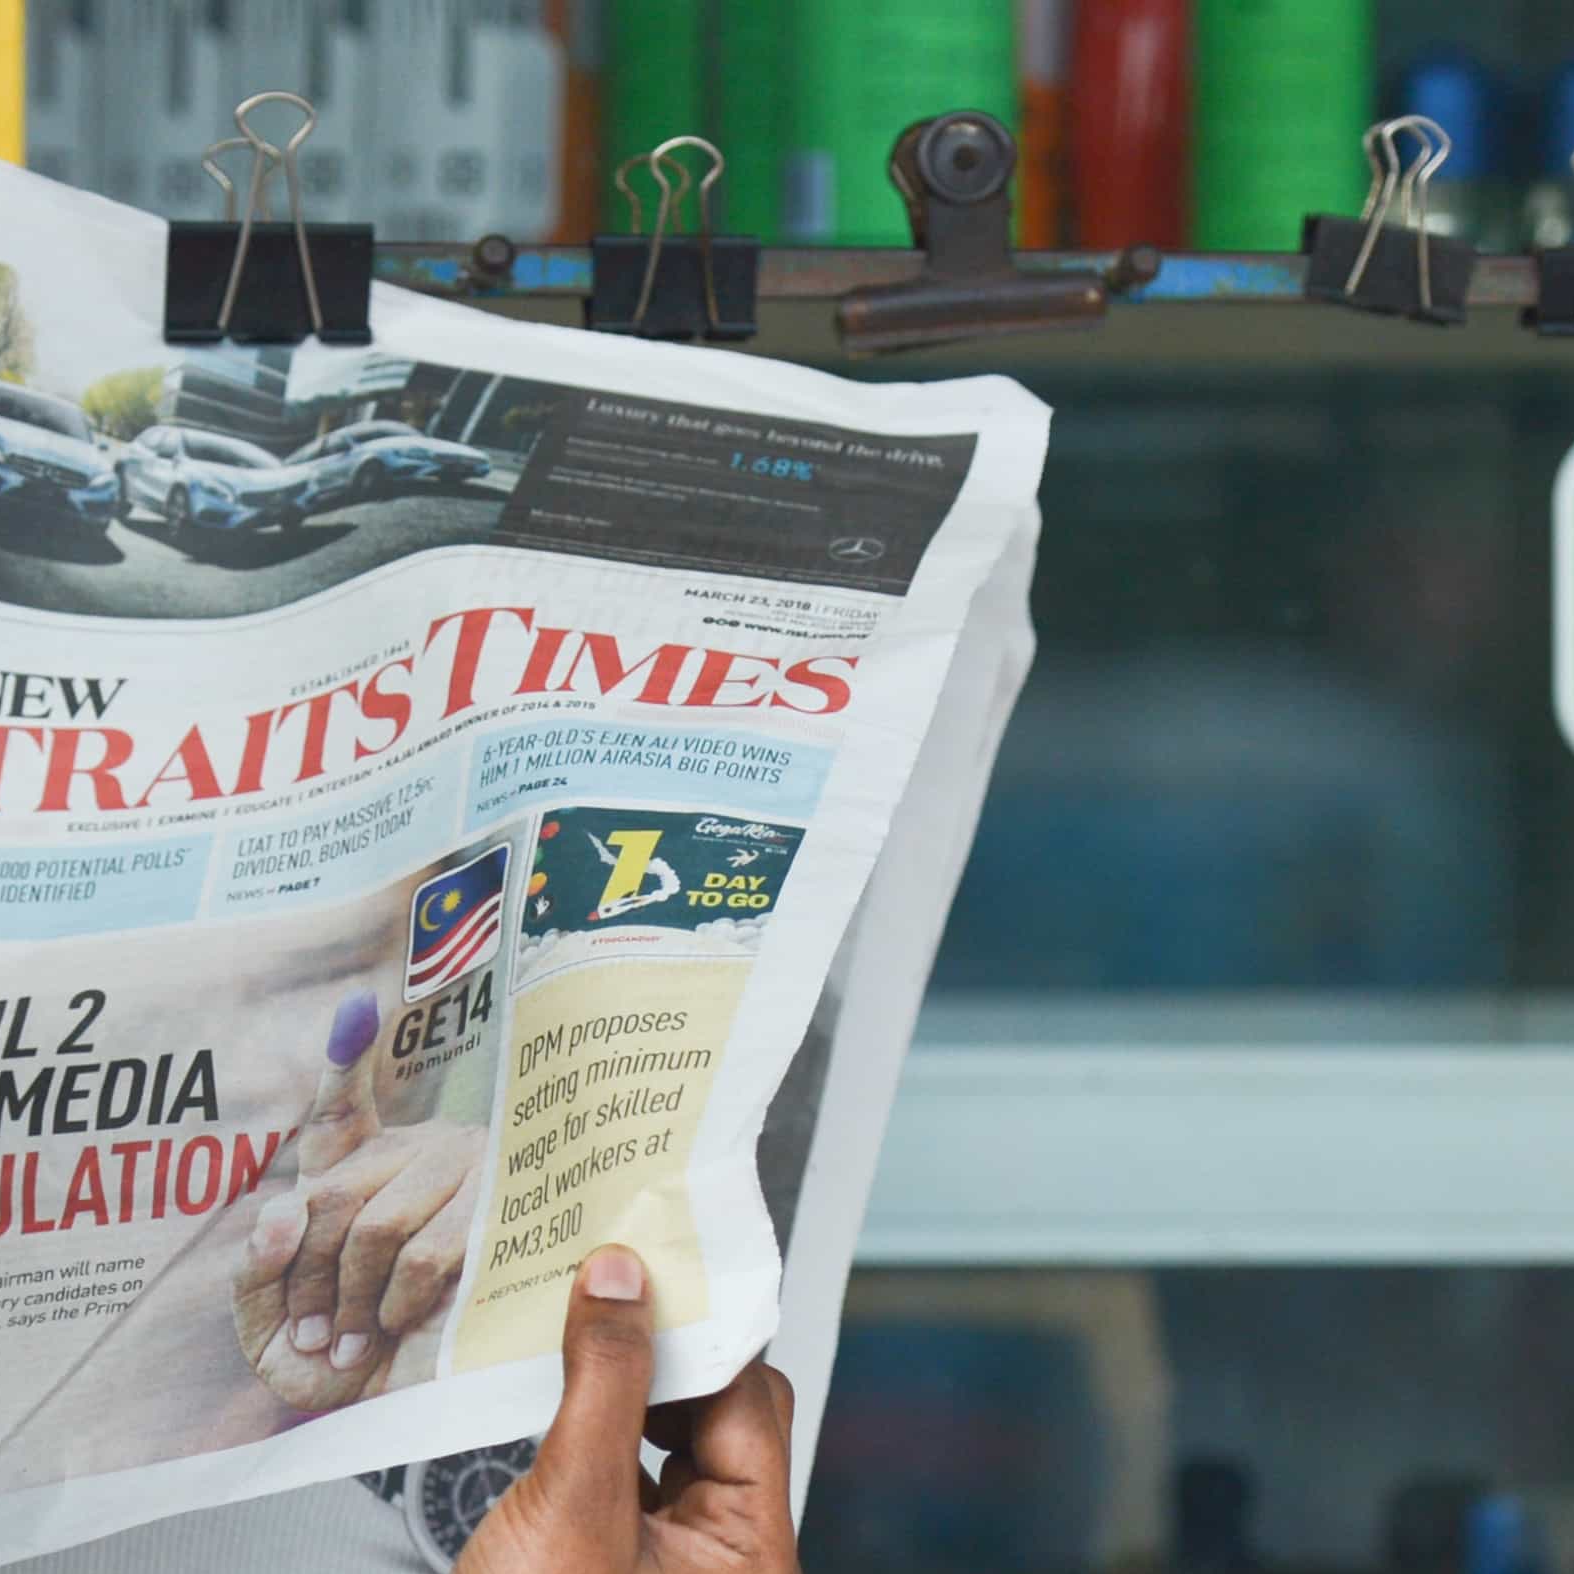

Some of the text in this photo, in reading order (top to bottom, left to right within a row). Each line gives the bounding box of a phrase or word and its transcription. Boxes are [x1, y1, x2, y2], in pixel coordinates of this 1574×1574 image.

[586, 397, 661, 425] Luxury
[667, 414, 709, 432] that
[847, 444, 881, 461] the
[729, 450, 816, 482] 1.68%
[684, 588, 745, 603] MARCH
[775, 599, 812, 612] 2018
[423, 607, 860, 720] TIMES
[481, 728, 793, 766] 6-YEAR-OLD'S EJEN ALI VIDEO WINS
[67, 819, 142, 833] EXCLUSIVE
[157, 808, 218, 826] EXAMINE
[234, 796, 293, 817] EDUCATE
[453, 709, 500, 737] WINNER
[501, 705, 518, 719] OF
[479, 763, 509, 790] HIM
[525, 749, 596, 771] MILLION
[598, 749, 673, 771] AIRASIA
[676, 755, 711, 776] BIG
[714, 761, 784, 785] POINTS
[518, 779, 549, 796] PAGE
[231, 806, 416, 882] DIVIDEND, BONUS TODAY
[236, 796, 393, 859] LTAT TO PAY MASSIVE
[33, 855, 126, 881] POTENTIAL
[277, 879, 308, 896] PAGE
[309, 878, 321, 890] 7
[703, 873, 767, 890] DAY
[0, 881, 97, 904] IDENTIFIED
[685, 890, 770, 908] TO GO
[56, 988, 108, 1056] 2
[392, 971, 494, 1060] GE14
[394, 1035, 483, 1082] #jomundi
[518, 1007, 689, 1079] DPM proposes
[512, 1045, 713, 1128] setting minimum
[507, 1085, 684, 1177] wage for skilled
[500, 1128, 674, 1225] local workers at
[488, 1202, 584, 1272] RM3,500
[59, 1260, 91, 1281] will
[94, 1254, 146, 1274] name
[543, 1270, 563, 1284] ON
[23, 1280, 117, 1308] candidates
[121, 1276, 144, 1292] on
[7, 1310, 47, 1331] says
[51, 1303, 78, 1322] the
